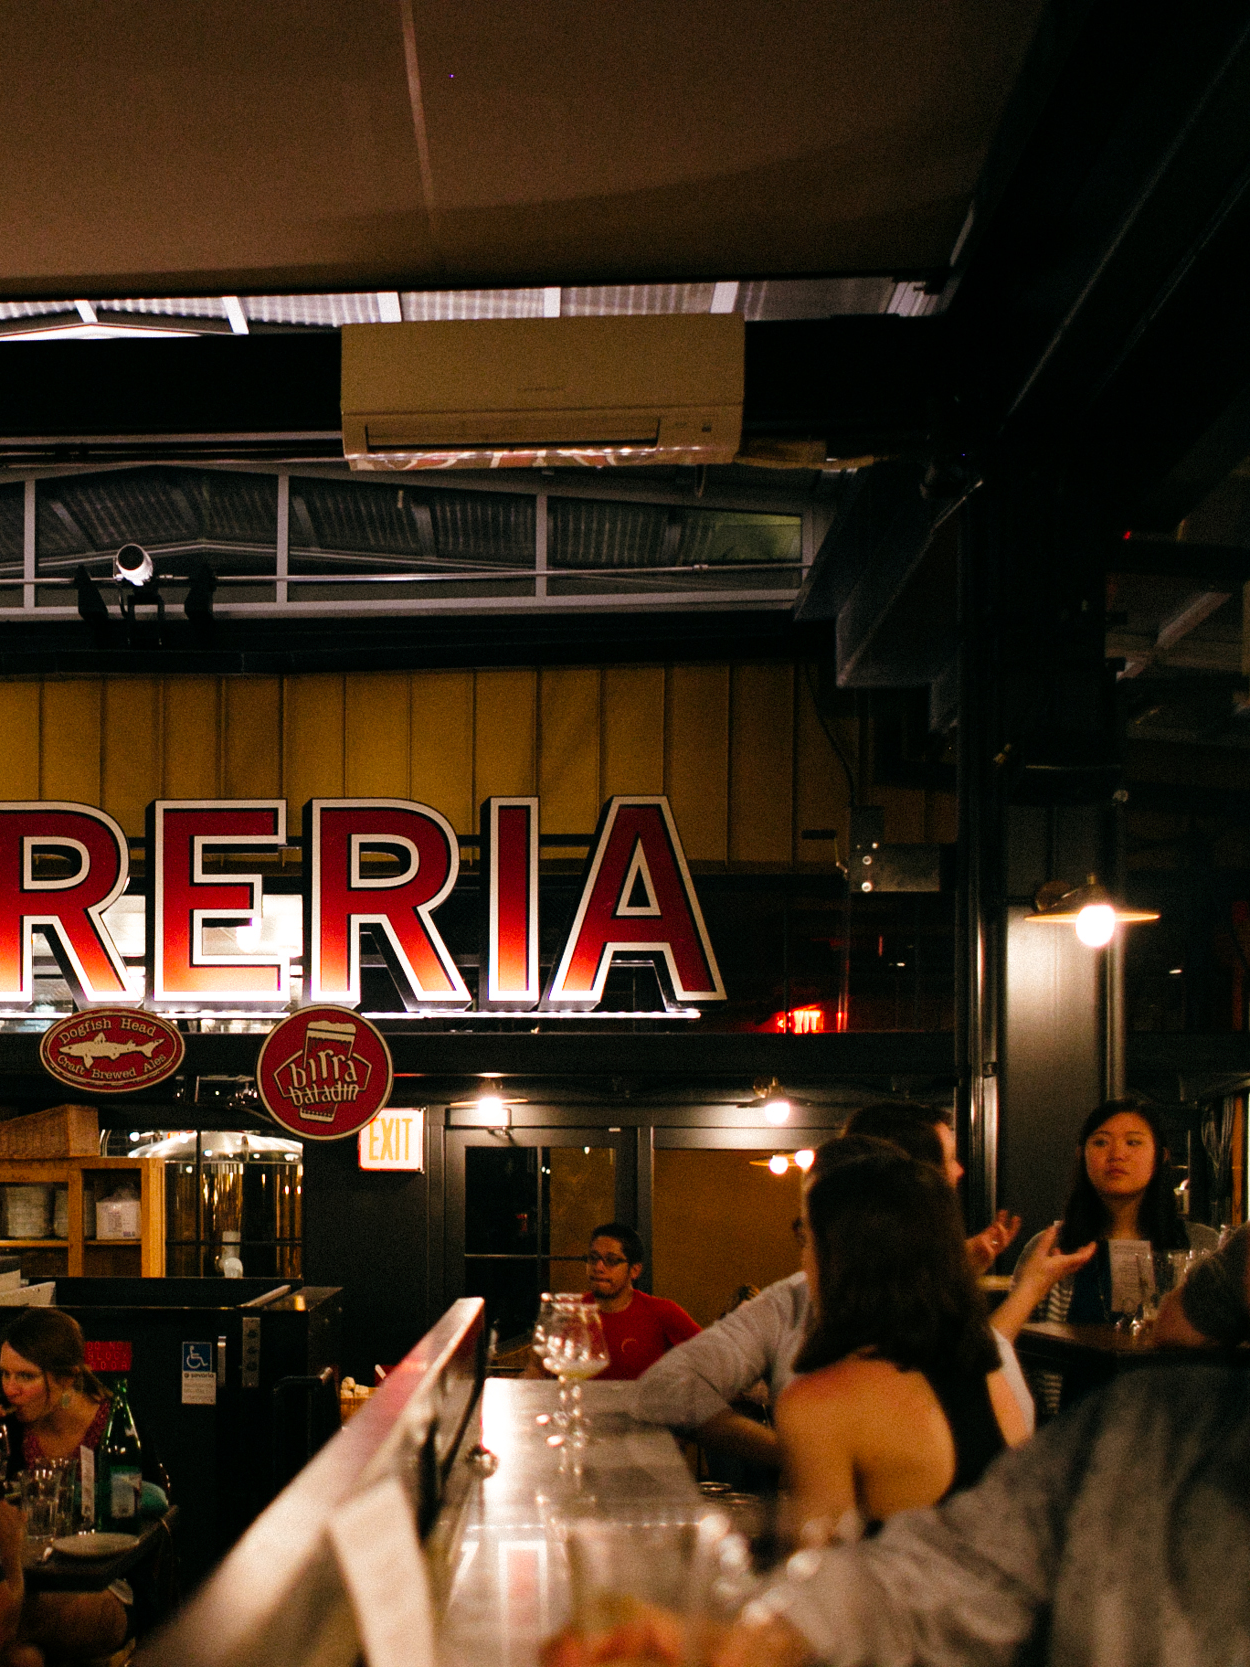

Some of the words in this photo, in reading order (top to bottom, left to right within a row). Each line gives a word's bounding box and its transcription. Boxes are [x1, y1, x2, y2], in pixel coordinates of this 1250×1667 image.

[58, 1017, 112, 1044] Dogfish
[120, 1017, 157, 1037] Head
[57, 1055, 85, 1075] Craft
[91, 1066, 137, 1079] Brewed
[143, 1053, 167, 1073] Ales
[289, 1049, 358, 1088] birra
[288, 1080, 360, 1106] baladin
[368, 1117, 414, 1161] EXIT
